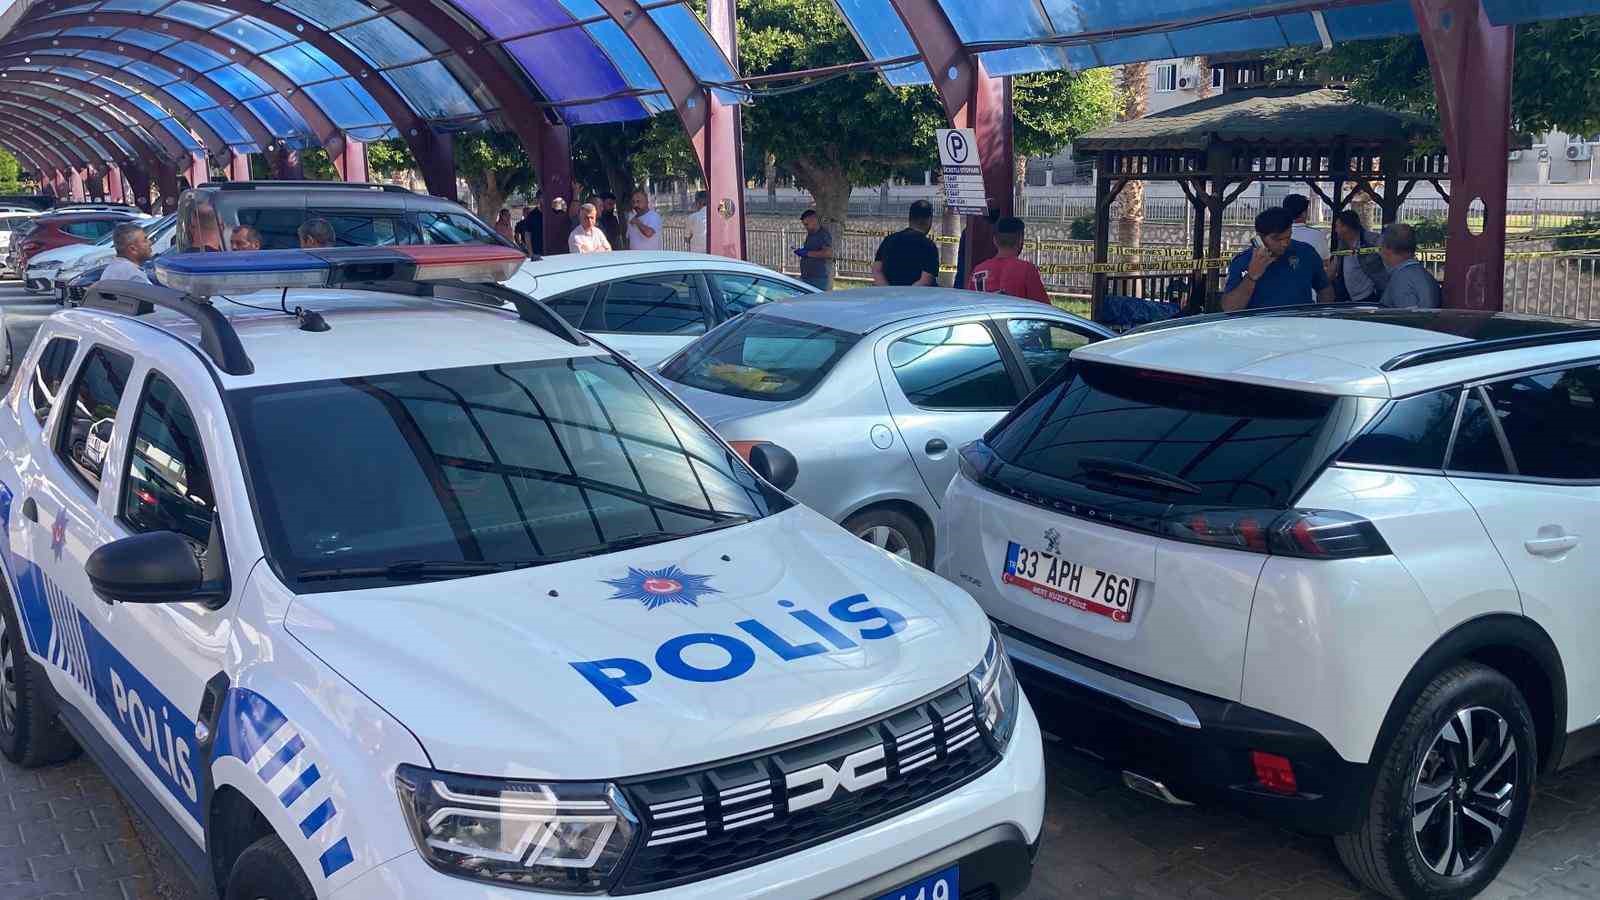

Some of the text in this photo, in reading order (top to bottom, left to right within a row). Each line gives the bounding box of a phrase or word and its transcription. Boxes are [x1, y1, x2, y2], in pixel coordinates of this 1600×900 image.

[951, 136, 963, 158] P
[1017, 548, 1039, 578] 33
[1047, 557, 1083, 593] APH
[1091, 570, 1130, 607] 766
[567, 593, 909, 708] POLİS
[110, 666, 198, 803] POLİS
